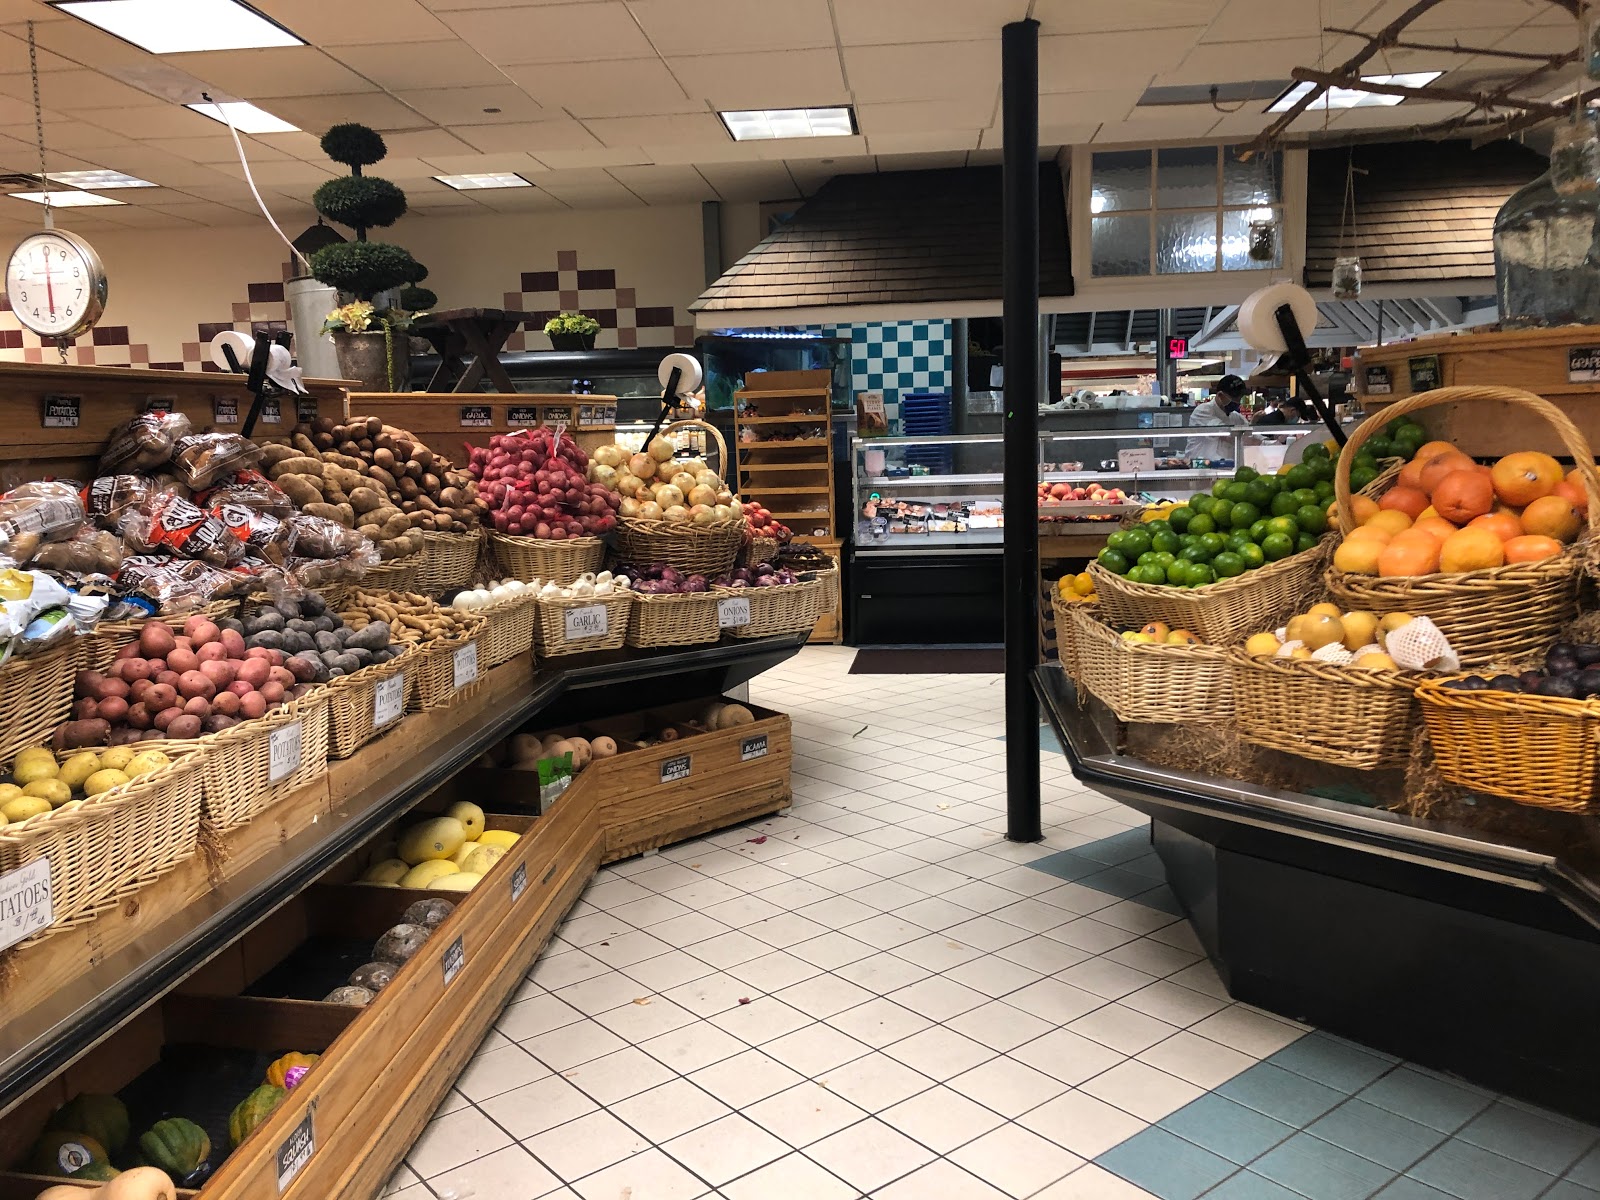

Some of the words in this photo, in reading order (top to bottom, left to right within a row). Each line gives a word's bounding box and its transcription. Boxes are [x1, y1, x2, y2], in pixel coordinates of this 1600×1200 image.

[59, 250, 67, 262] 9
[20, 291, 28, 303] 3
[75, 288, 83, 300] 7
[32, 307, 40, 319] 4
[65, 305, 73, 317] 6
[50, 313, 57, 324] 5
[49, 405, 78, 417] POTATOES
[512, 412, 534, 420] ONIONS
[548, 412, 569, 420] ONIONS
[723, 606, 748, 616] ONIONS
[573, 614, 601, 627] GARLIC
[282, 1127, 309, 1170] SQUASH
